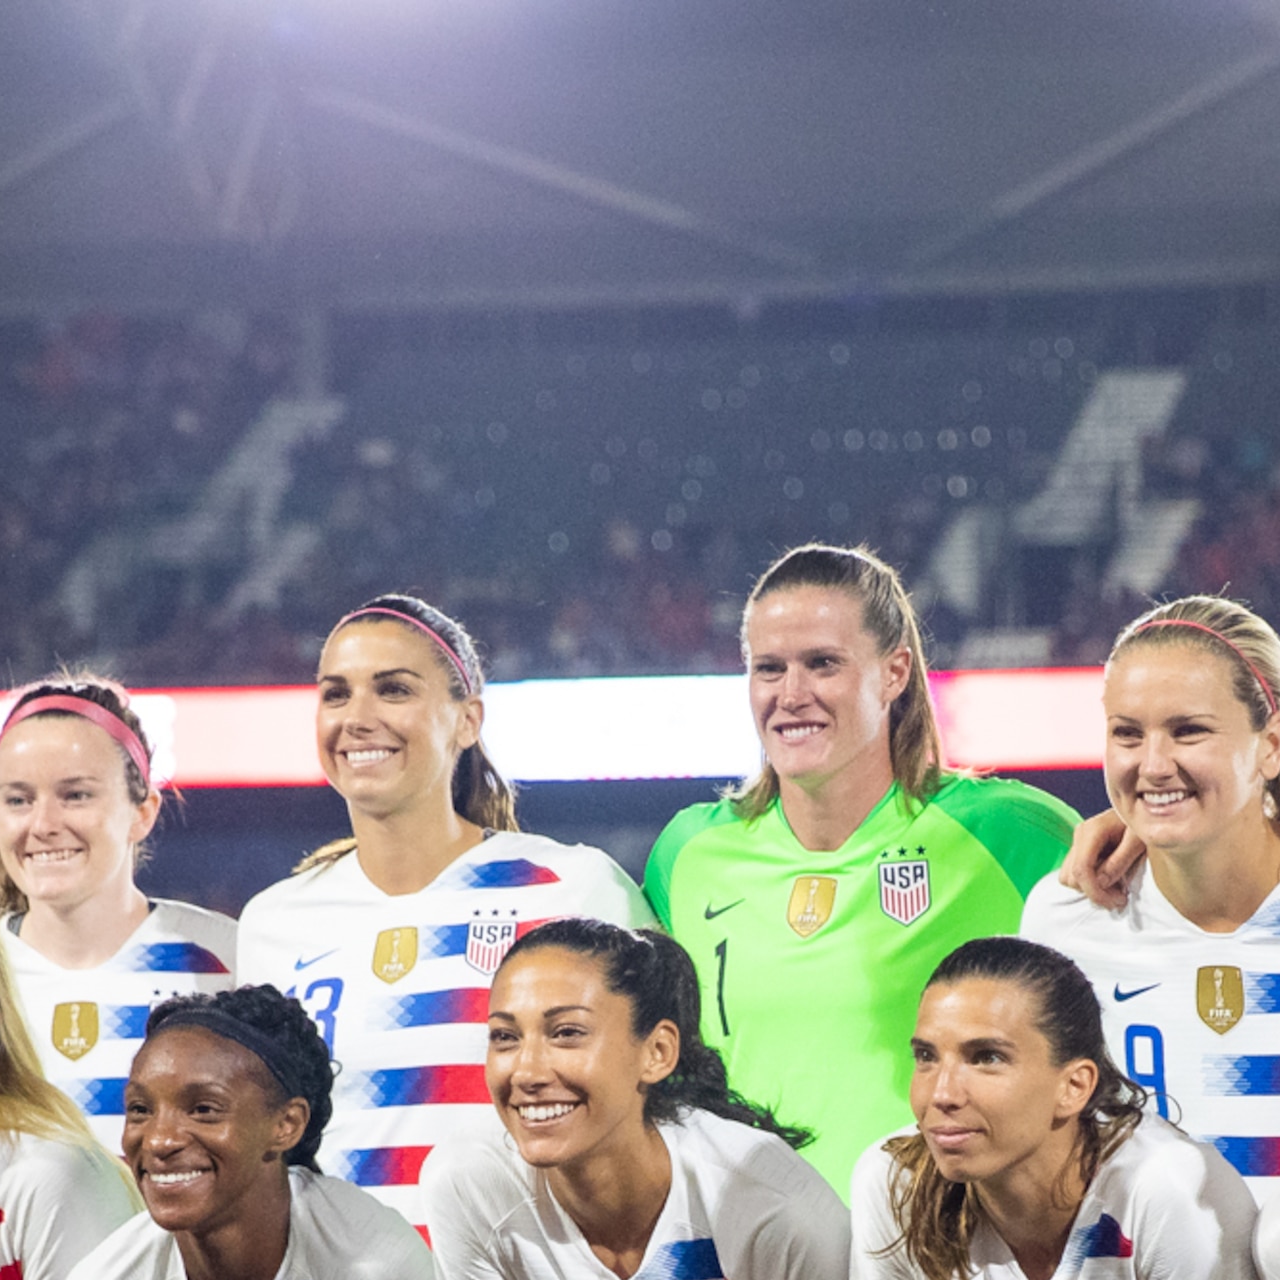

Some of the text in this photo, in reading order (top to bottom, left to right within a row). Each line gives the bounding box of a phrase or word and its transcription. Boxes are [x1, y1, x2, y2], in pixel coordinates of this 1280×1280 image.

[883, 863, 926, 889] USA
[472, 925, 513, 944] USA
[715, 939, 729, 1036] 1
[285, 977, 344, 1060] 3
[1208, 1008, 1232, 1018] FIFA
[62, 1037, 87, 1048] FIFA
[1125, 1023, 1168, 1120] 9
